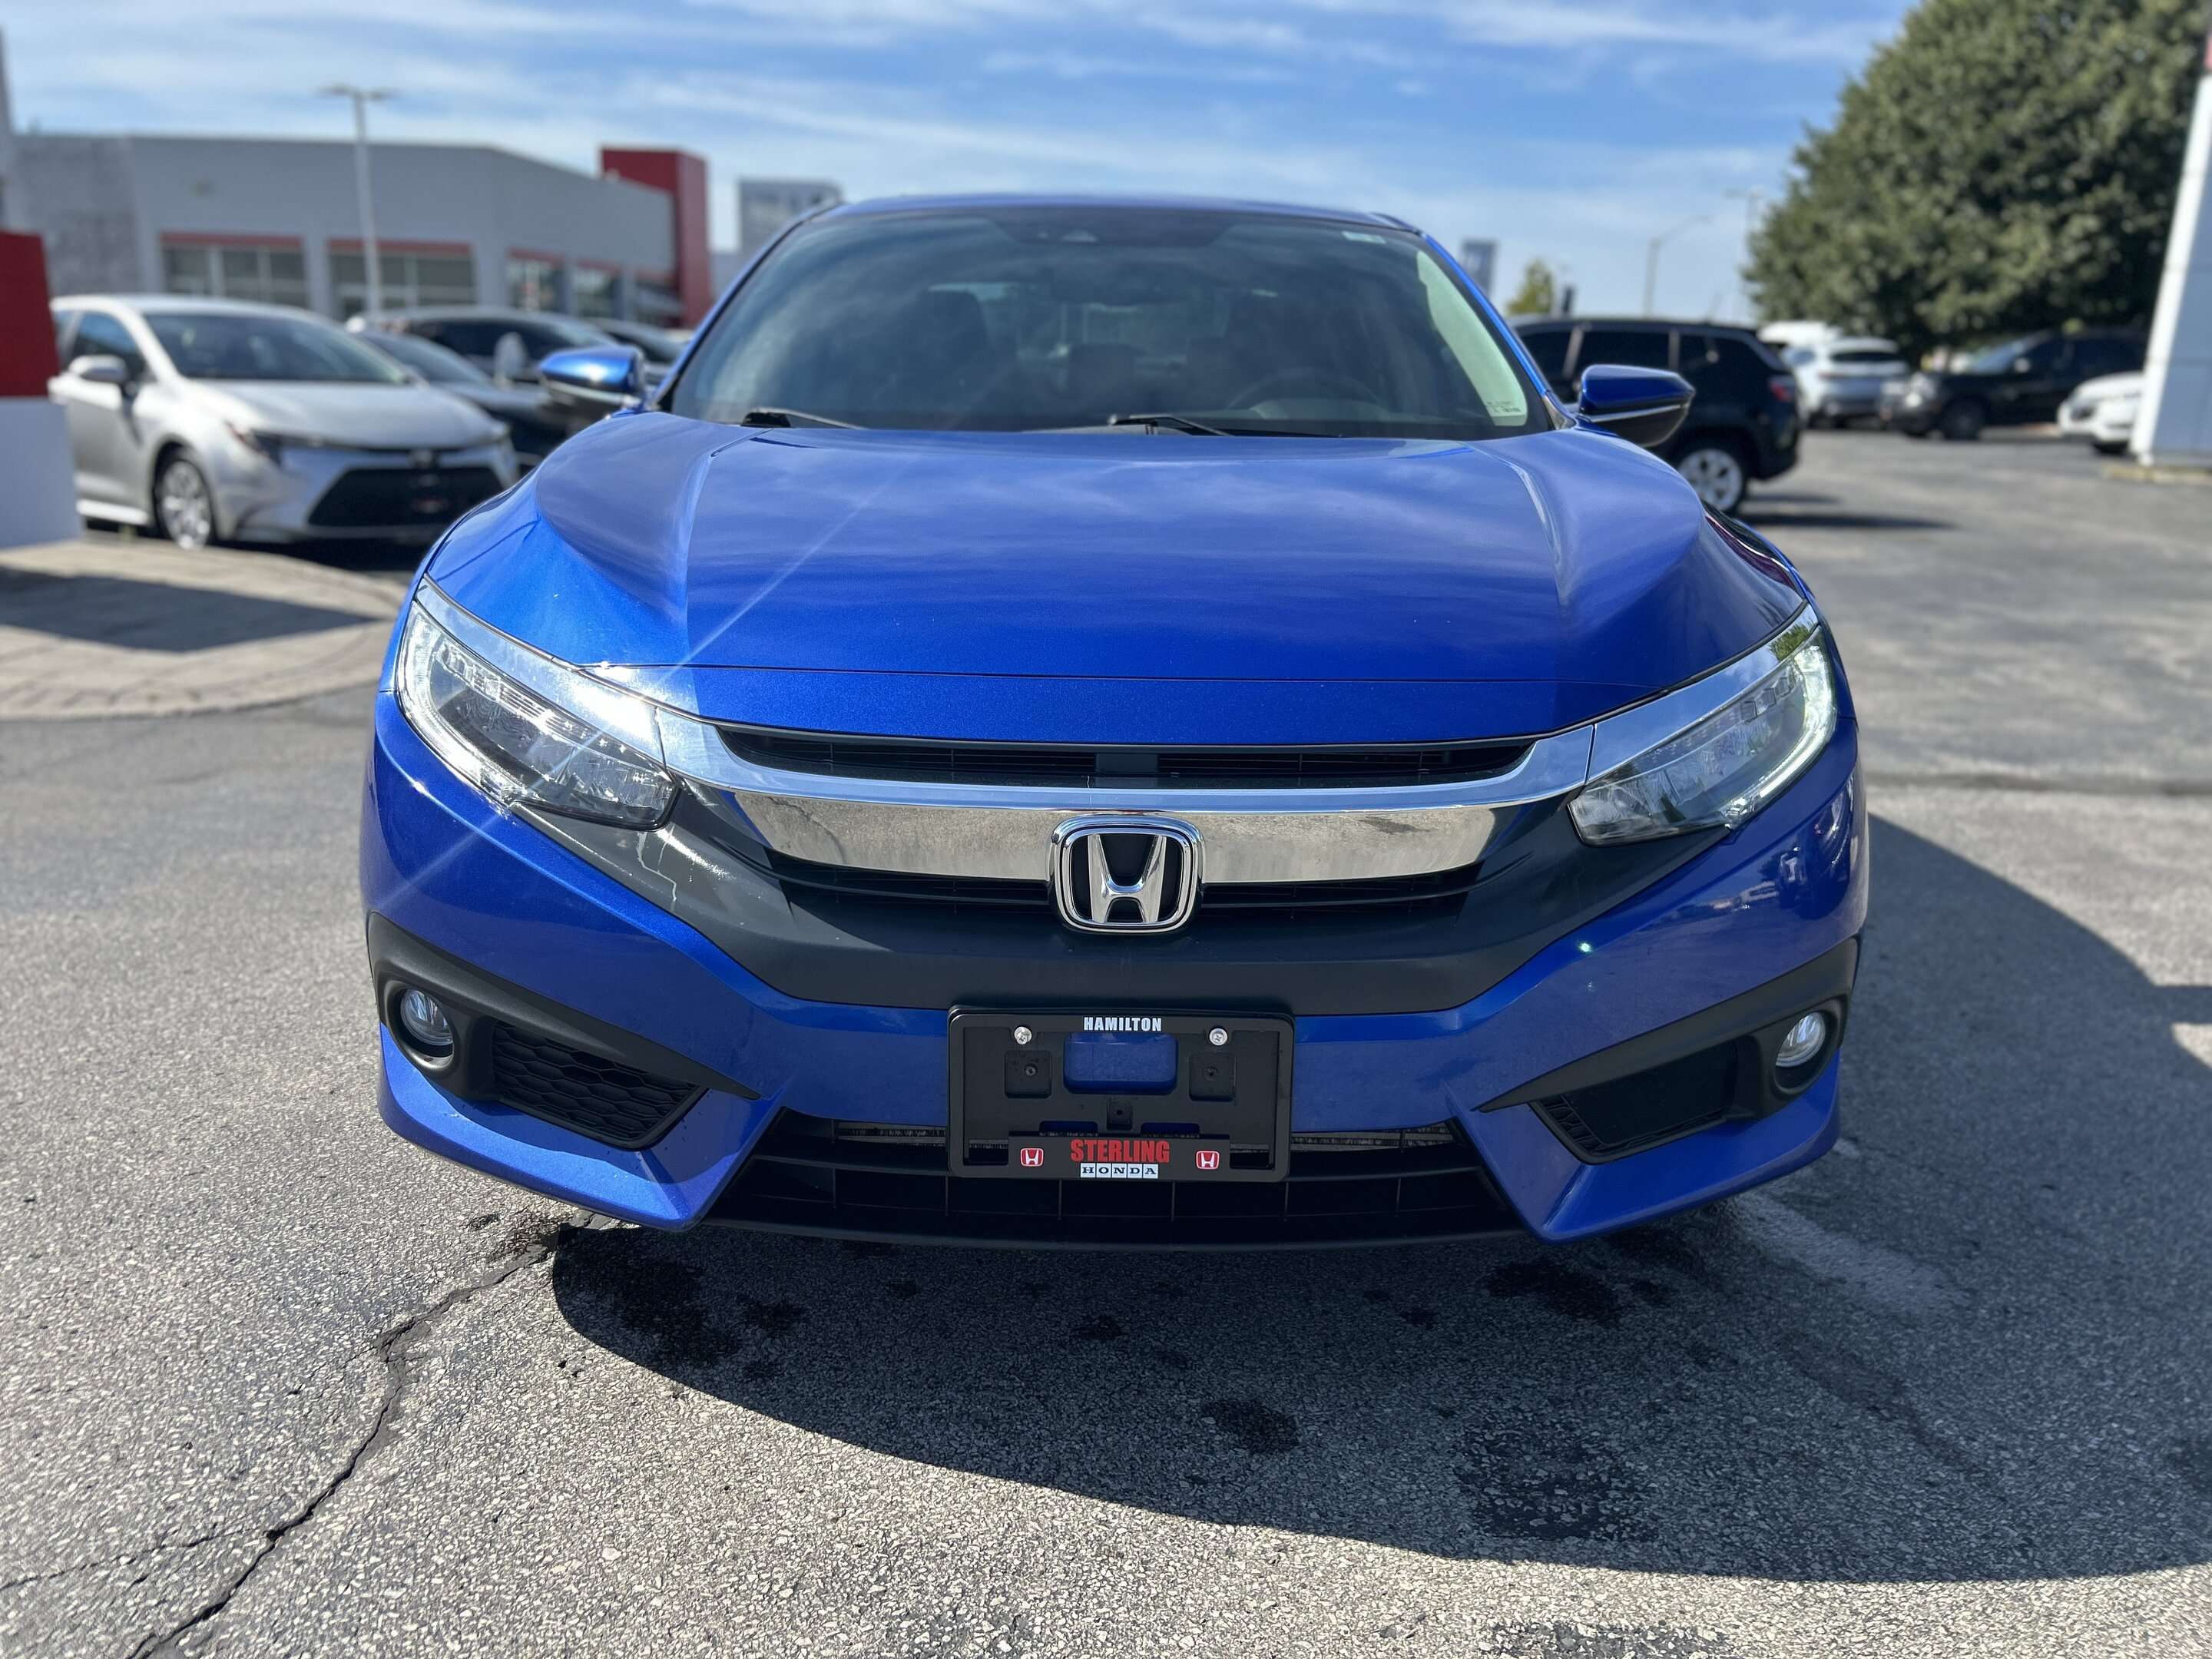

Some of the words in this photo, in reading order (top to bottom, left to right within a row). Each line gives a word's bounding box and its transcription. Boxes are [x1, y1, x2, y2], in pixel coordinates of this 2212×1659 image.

[1083, 1016, 1162, 1031] HAMILTON
[1070, 1139, 1170, 1163] STERLING
[1081, 1166, 1157, 1175] HONDA
